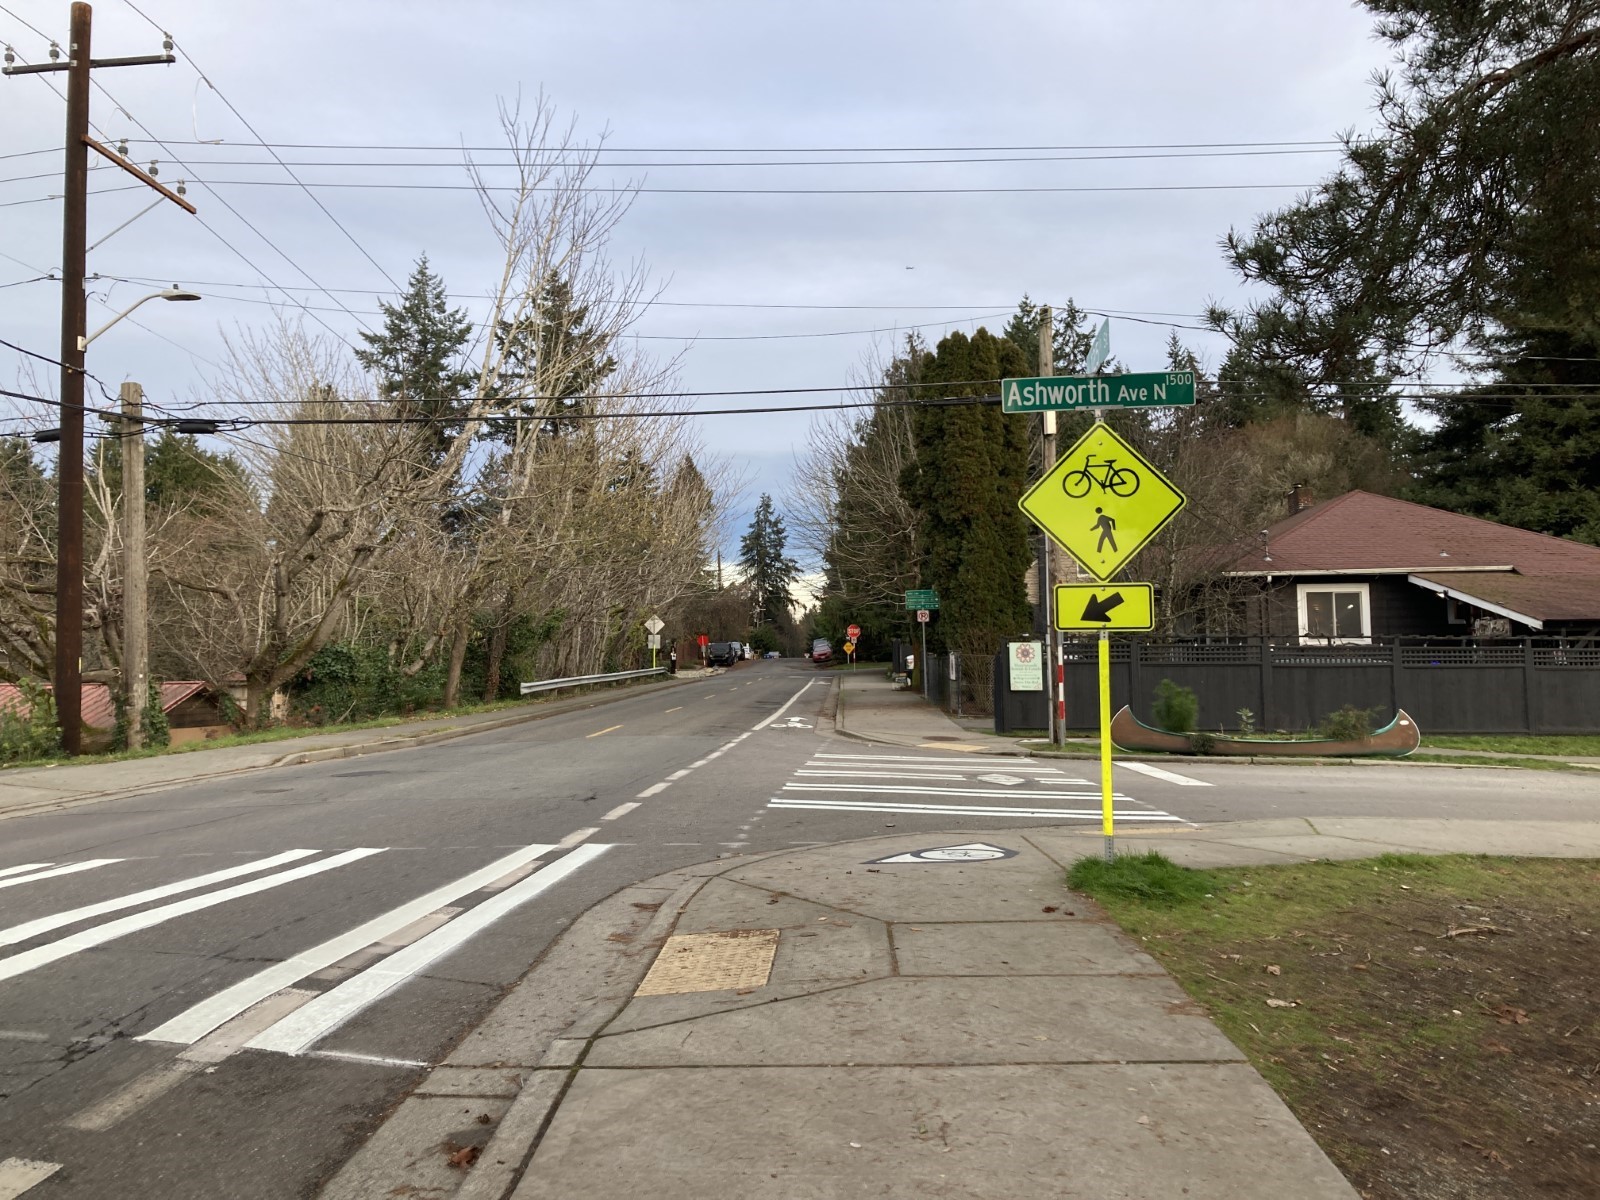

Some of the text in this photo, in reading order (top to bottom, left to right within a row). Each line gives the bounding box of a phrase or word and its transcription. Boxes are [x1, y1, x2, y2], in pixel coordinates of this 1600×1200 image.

[1165, 374, 1192, 386] 1500
[1007, 379, 1167, 407] Ashworth Ave N
